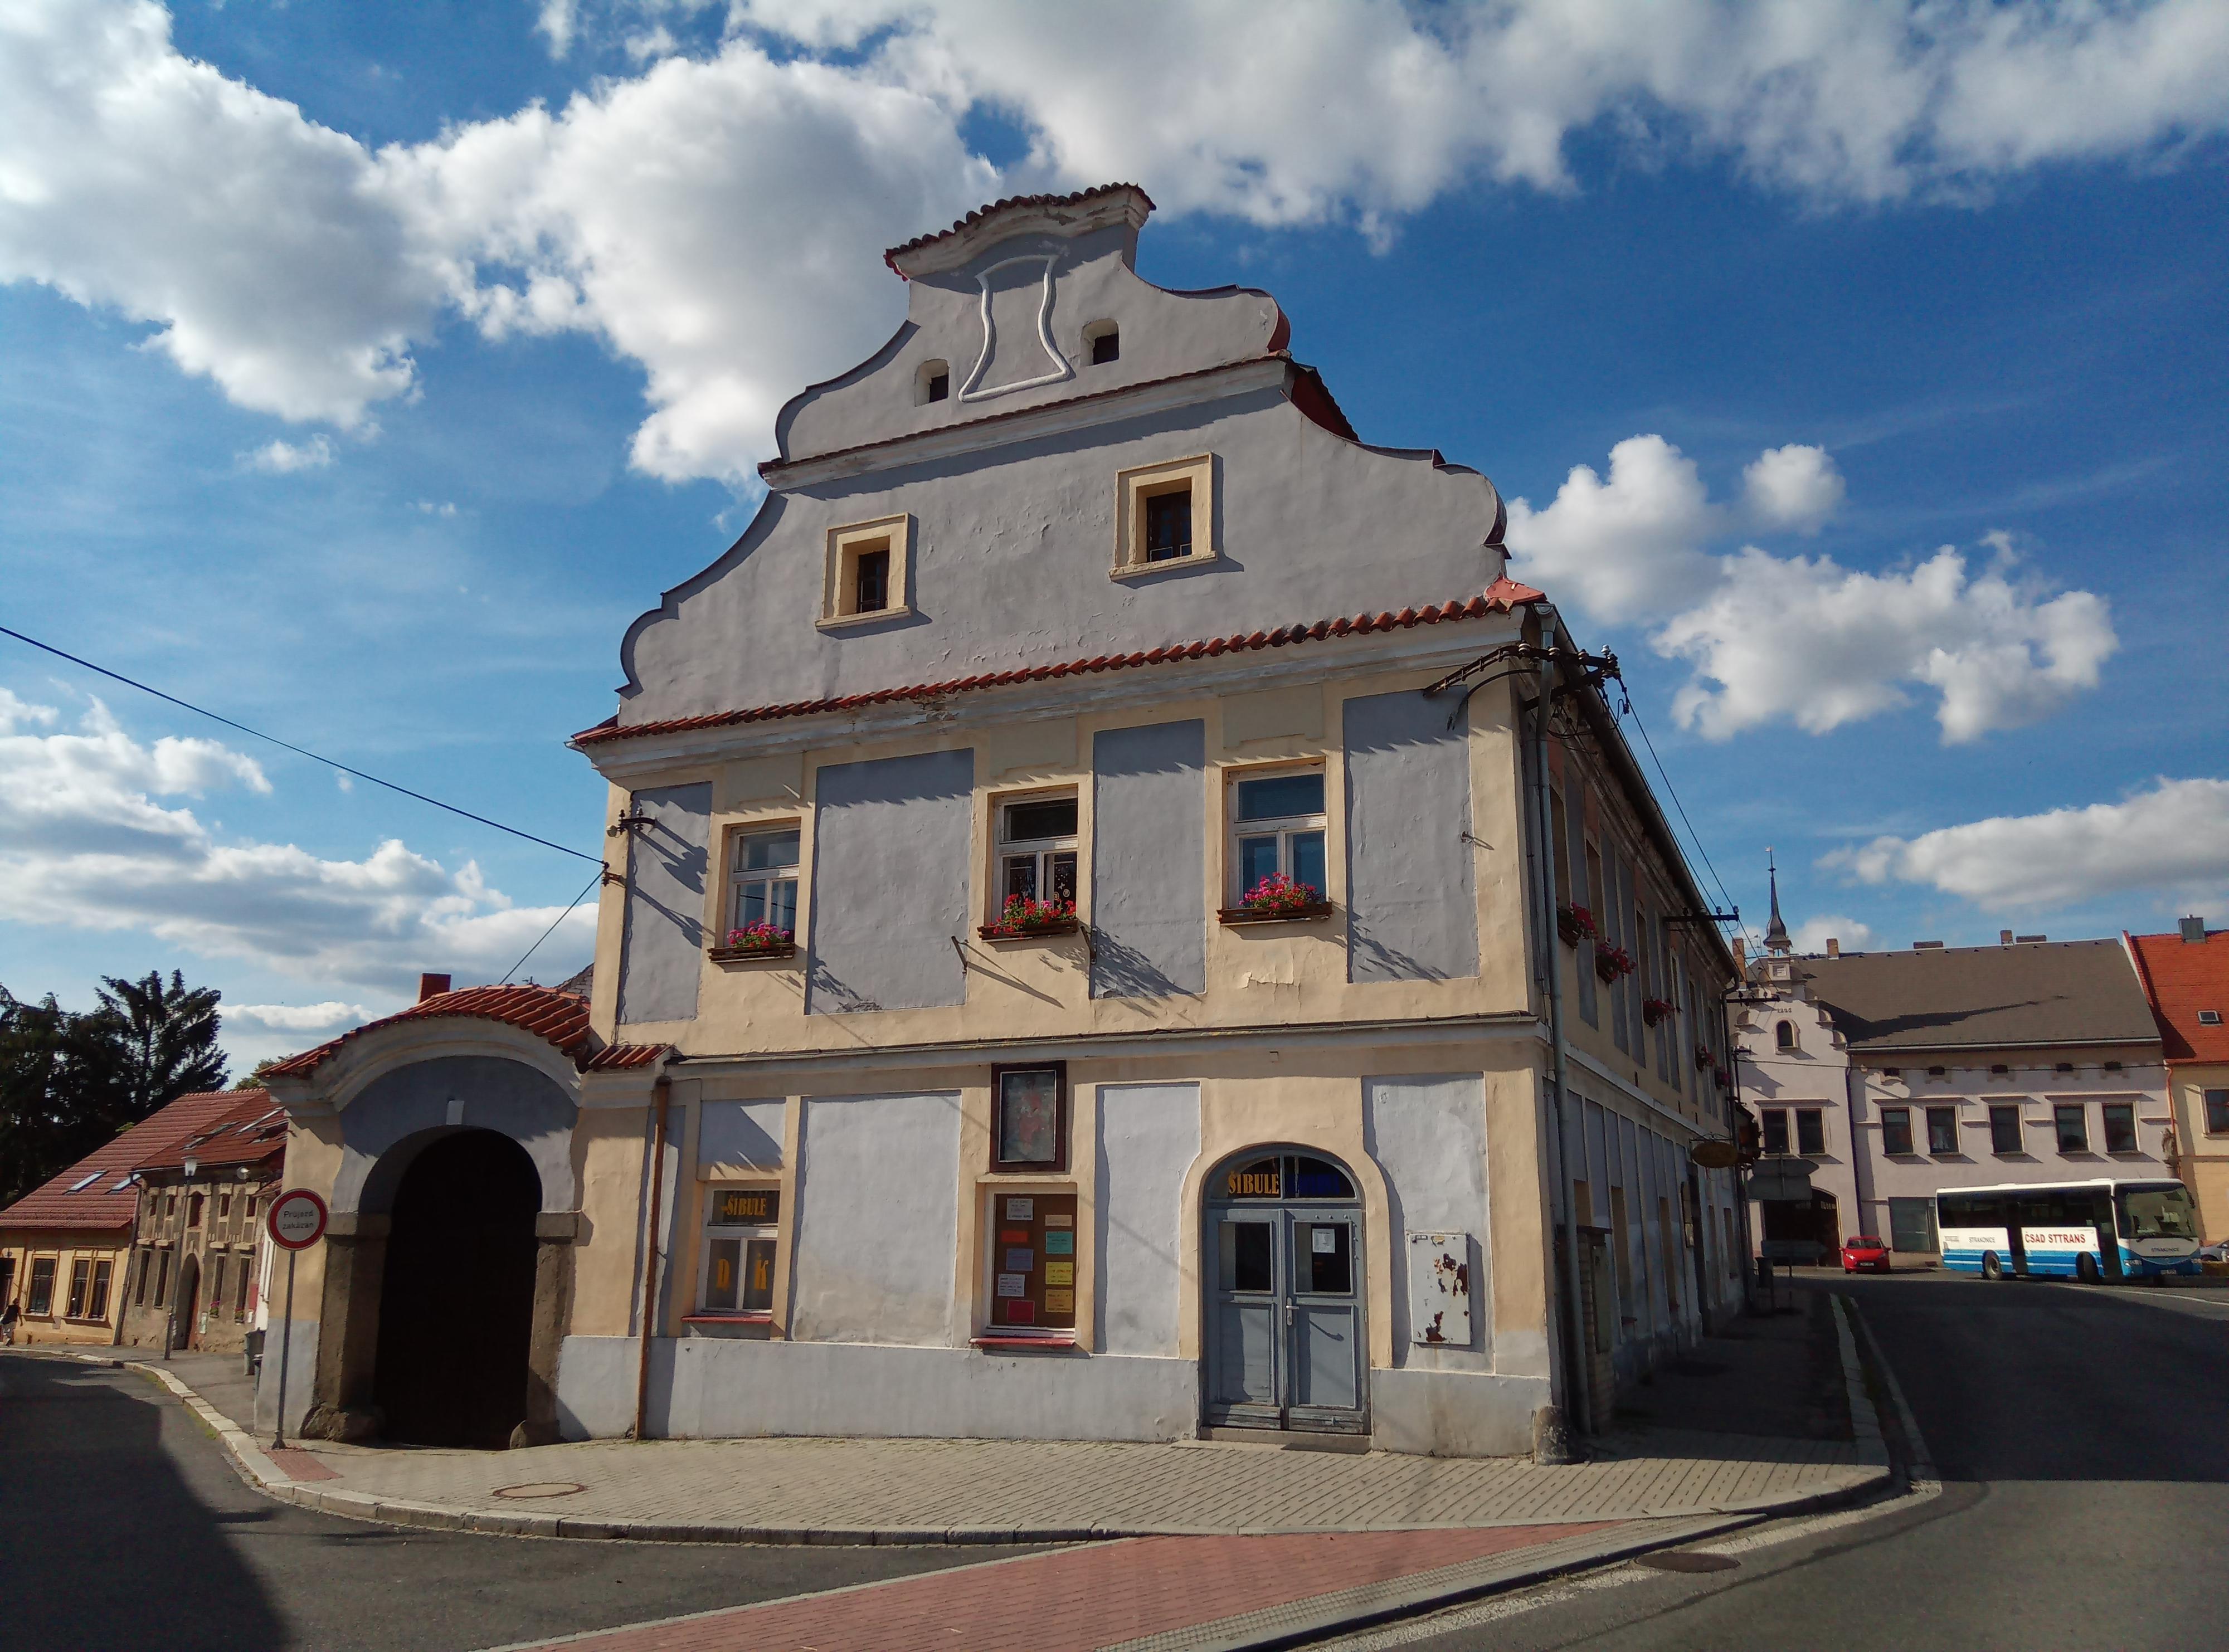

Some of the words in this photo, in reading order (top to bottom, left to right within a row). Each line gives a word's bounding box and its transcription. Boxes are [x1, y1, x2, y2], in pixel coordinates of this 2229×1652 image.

[1228, 1171, 1279, 1194] ŠIBULE
[2025, 1231, 2046, 1244] ČSAD
[2048, 1233, 2086, 1244] STTRANS
